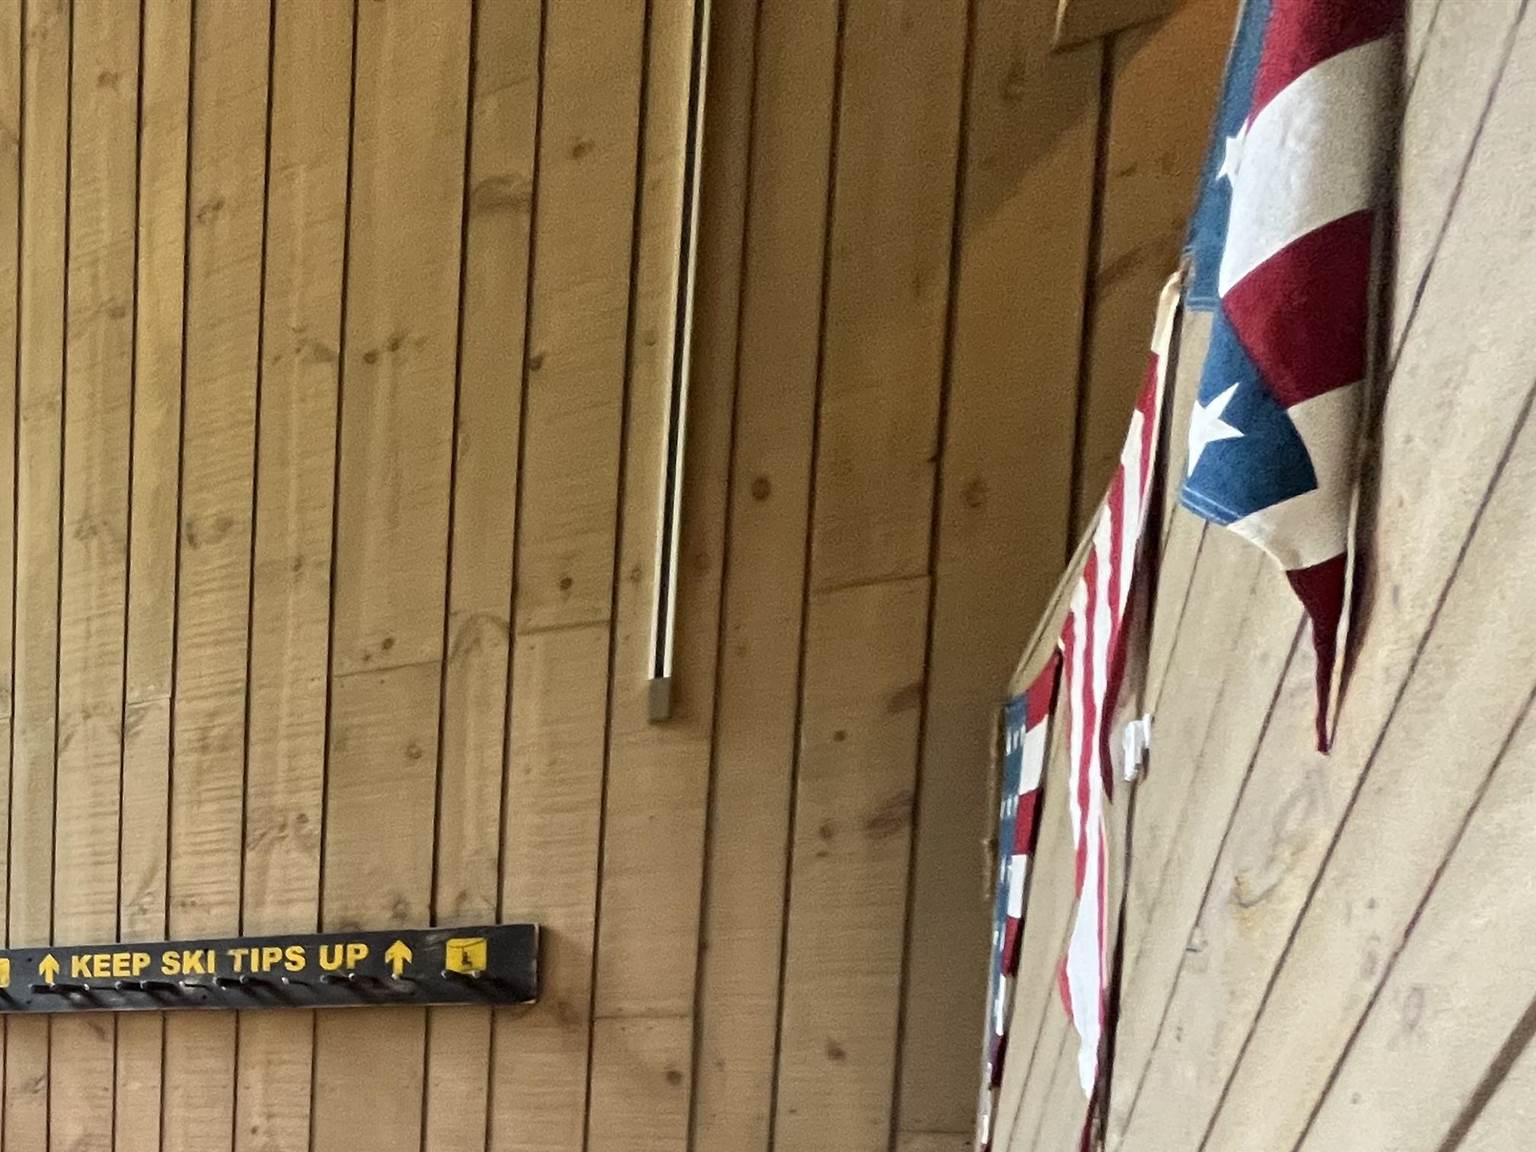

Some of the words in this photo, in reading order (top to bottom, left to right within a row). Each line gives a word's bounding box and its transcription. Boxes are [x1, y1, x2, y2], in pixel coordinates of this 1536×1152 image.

[71, 952, 151, 978] KEEP
[161, 949, 215, 976] SKI
[226, 945, 306, 974] TIPS
[319, 943, 369, 971] UP
